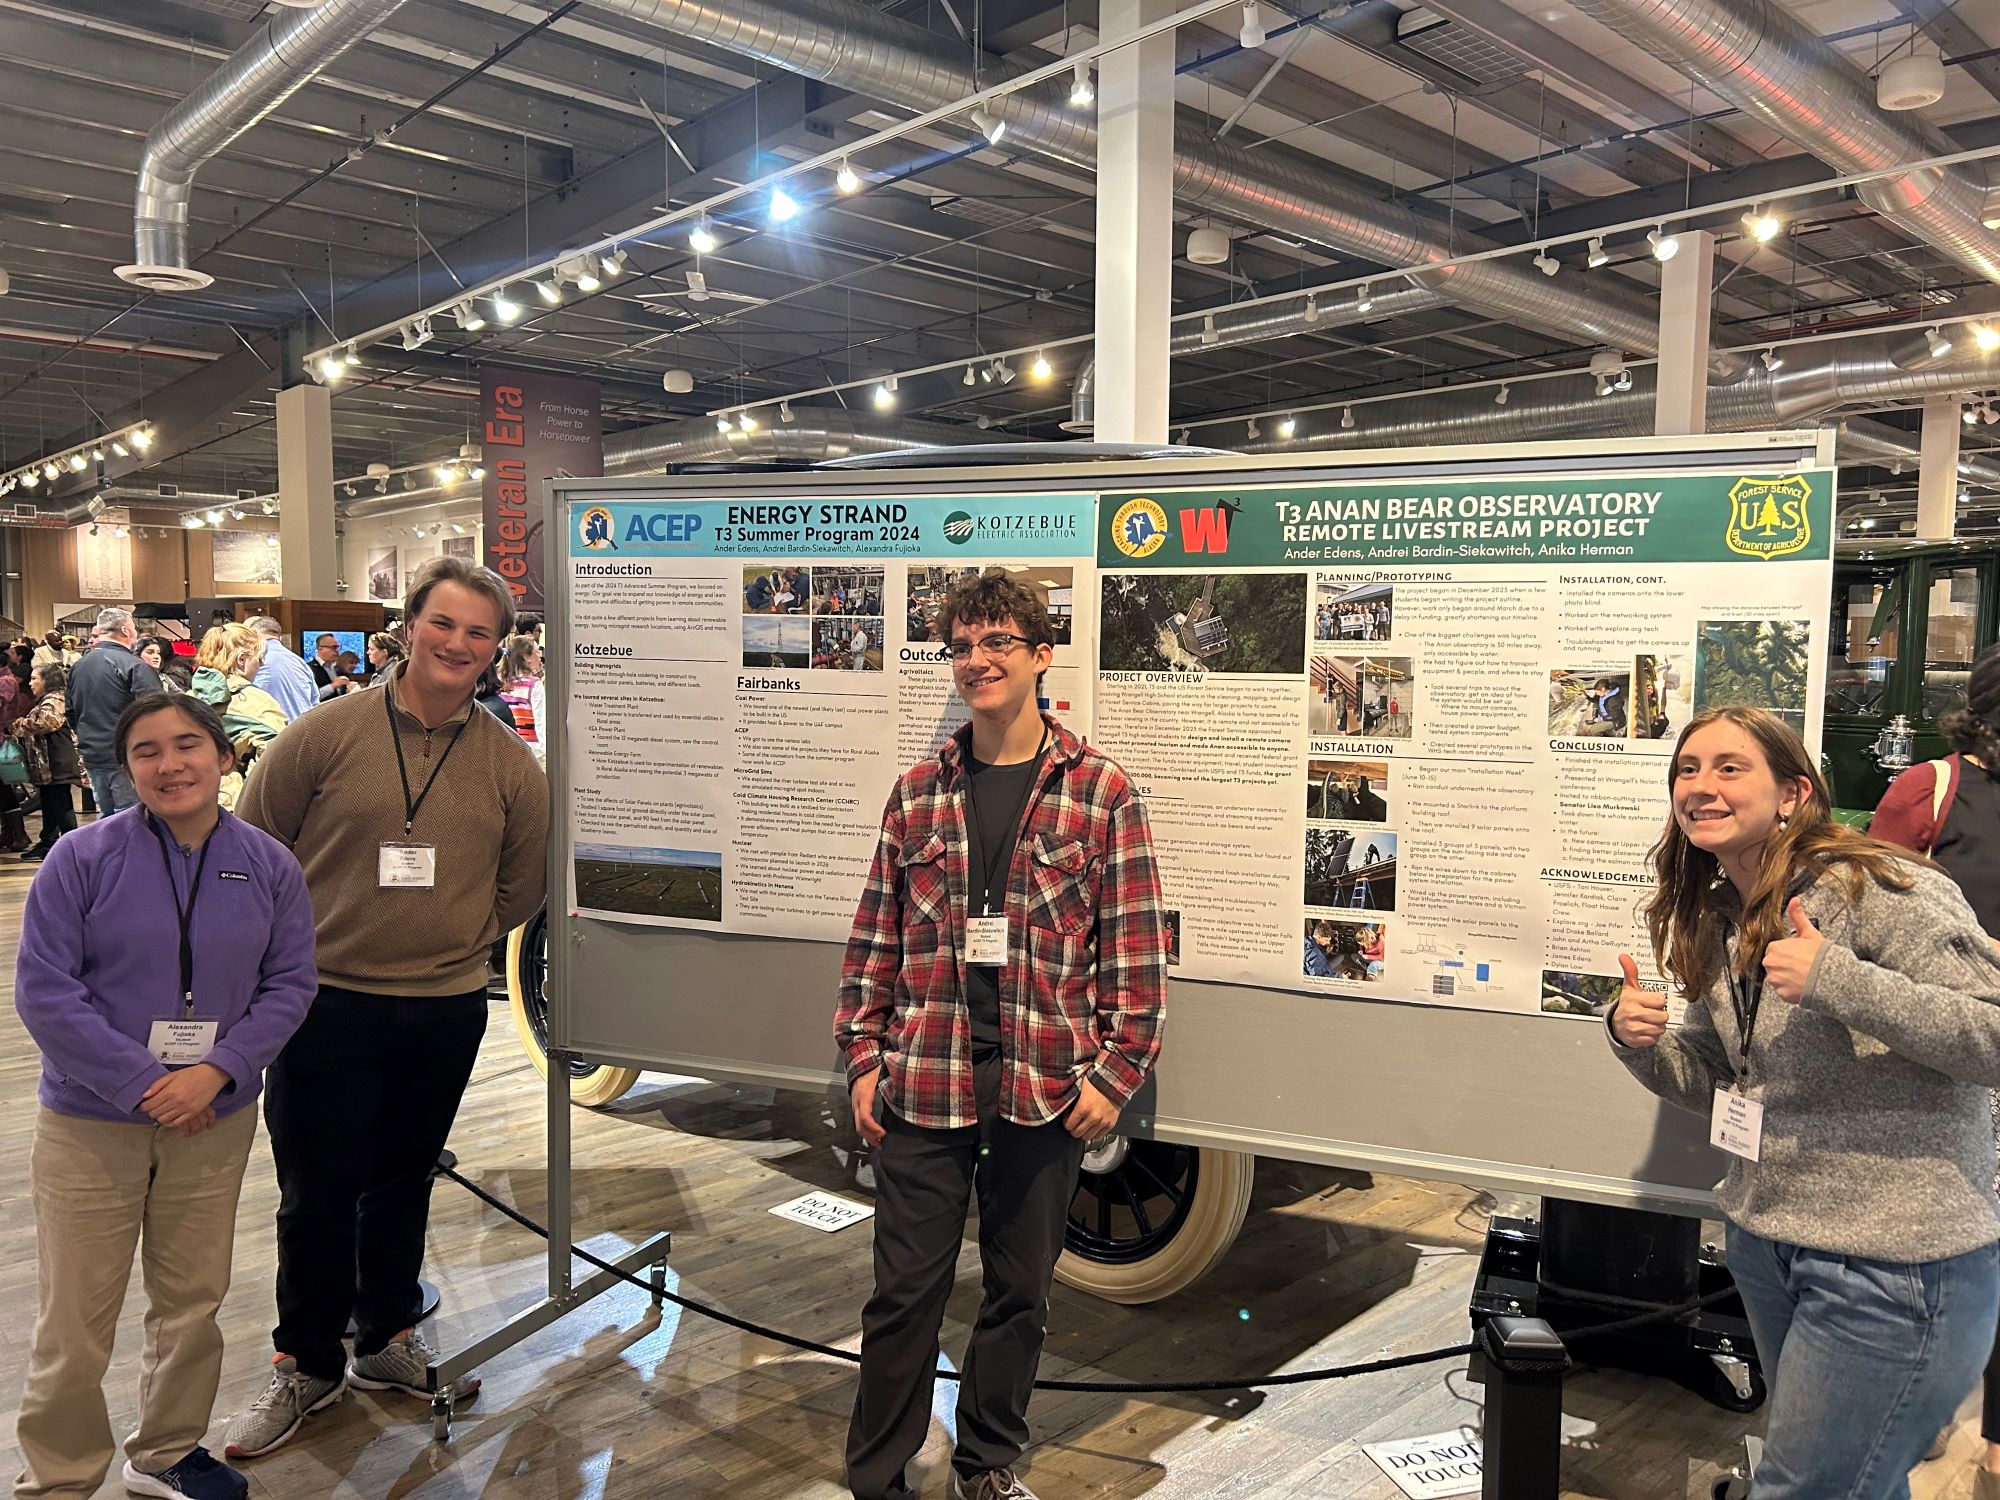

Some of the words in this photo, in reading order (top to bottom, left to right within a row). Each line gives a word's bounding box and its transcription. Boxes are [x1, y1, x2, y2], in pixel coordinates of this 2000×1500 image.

[540, 402, 562, 414] From
[564, 404, 590, 416] Horse
[486, 386, 524, 447] Era
[548, 416, 572, 428] Power
[574, 419, 583, 428] to
[540, 430, 591, 444] Horsepower
[1738, 486, 1768, 500] FOREST
[1770, 486, 1802, 498] SERVICE
[1116, 502, 1138, 522] THROUGH
[1140, 502, 1165, 528] TECHNOLOGY
[1276, 502, 1300, 524] T3
[1306, 499, 1379, 522] ANAN
[1387, 497, 1453, 519] BEAR
[1459, 492, 1662, 517] OBSERVATORY
[729, 505, 812, 526] ENERGY
[821, 505, 906, 524] STRAND
[978, 514, 1076, 530] KOTZEBUE
[625, 514, 702, 542] ACEP
[978, 530, 1015, 539] ELECTRIC
[1020, 530, 1076, 538] ASSOCIATION
[1284, 524, 1375, 541] REMOTE
[1383, 520, 1531, 540] LIVESTREAM
[1540, 518, 1648, 538] PROJECT
[716, 528, 732, 543] T3
[738, 528, 799, 543] Summer
[806, 527, 873, 545] Program
[880, 526, 920, 542] 2024
[1115, 524, 1129, 552] TEACHING
[1732, 529, 1762, 550] DEPARTMENT
[1772, 528, 1805, 550] AGRICULTURE
[738, 544, 760, 553] Edens,
[895, 544, 920, 554] Fujioka
[1144, 538, 1160, 553] ALASKA
[1285, 546, 1321, 559] Ander
[1324, 546, 1364, 559] Edens,
[1368, 545, 1408, 557] Andrei
[1413, 543, 1534, 557] Bardin-Siekawitch,
[1538, 543, 1575, 555] Anika
[1581, 543, 1633, 555] Herman
[576, 564, 651, 575] Introduction
[1316, 572, 1452, 581] PLANNING/PROTOTYPING
[1560, 576, 1633, 584] INSTALLATION,
[575, 644, 632, 657] Kotzebue
[738, 677, 800, 690] Fairbanks
[1100, 673, 1142, 684] PROJECT
[1146, 673, 1203, 684] OVERVIEW
[1311, 742, 1393, 754] INSTALLATION
[1550, 740, 1623, 752] CONCLUSION
[574, 788, 585, 796] Plant
[732, 880, 767, 888] Hydrokinetics
[791, 1205, 842, 1224] TOUCH
[802, 1198, 826, 1208] DO
[826, 1206, 862, 1218] NOT
[1386, 1453, 1426, 1468] DO
[1429, 1442, 1482, 1462] NOT
